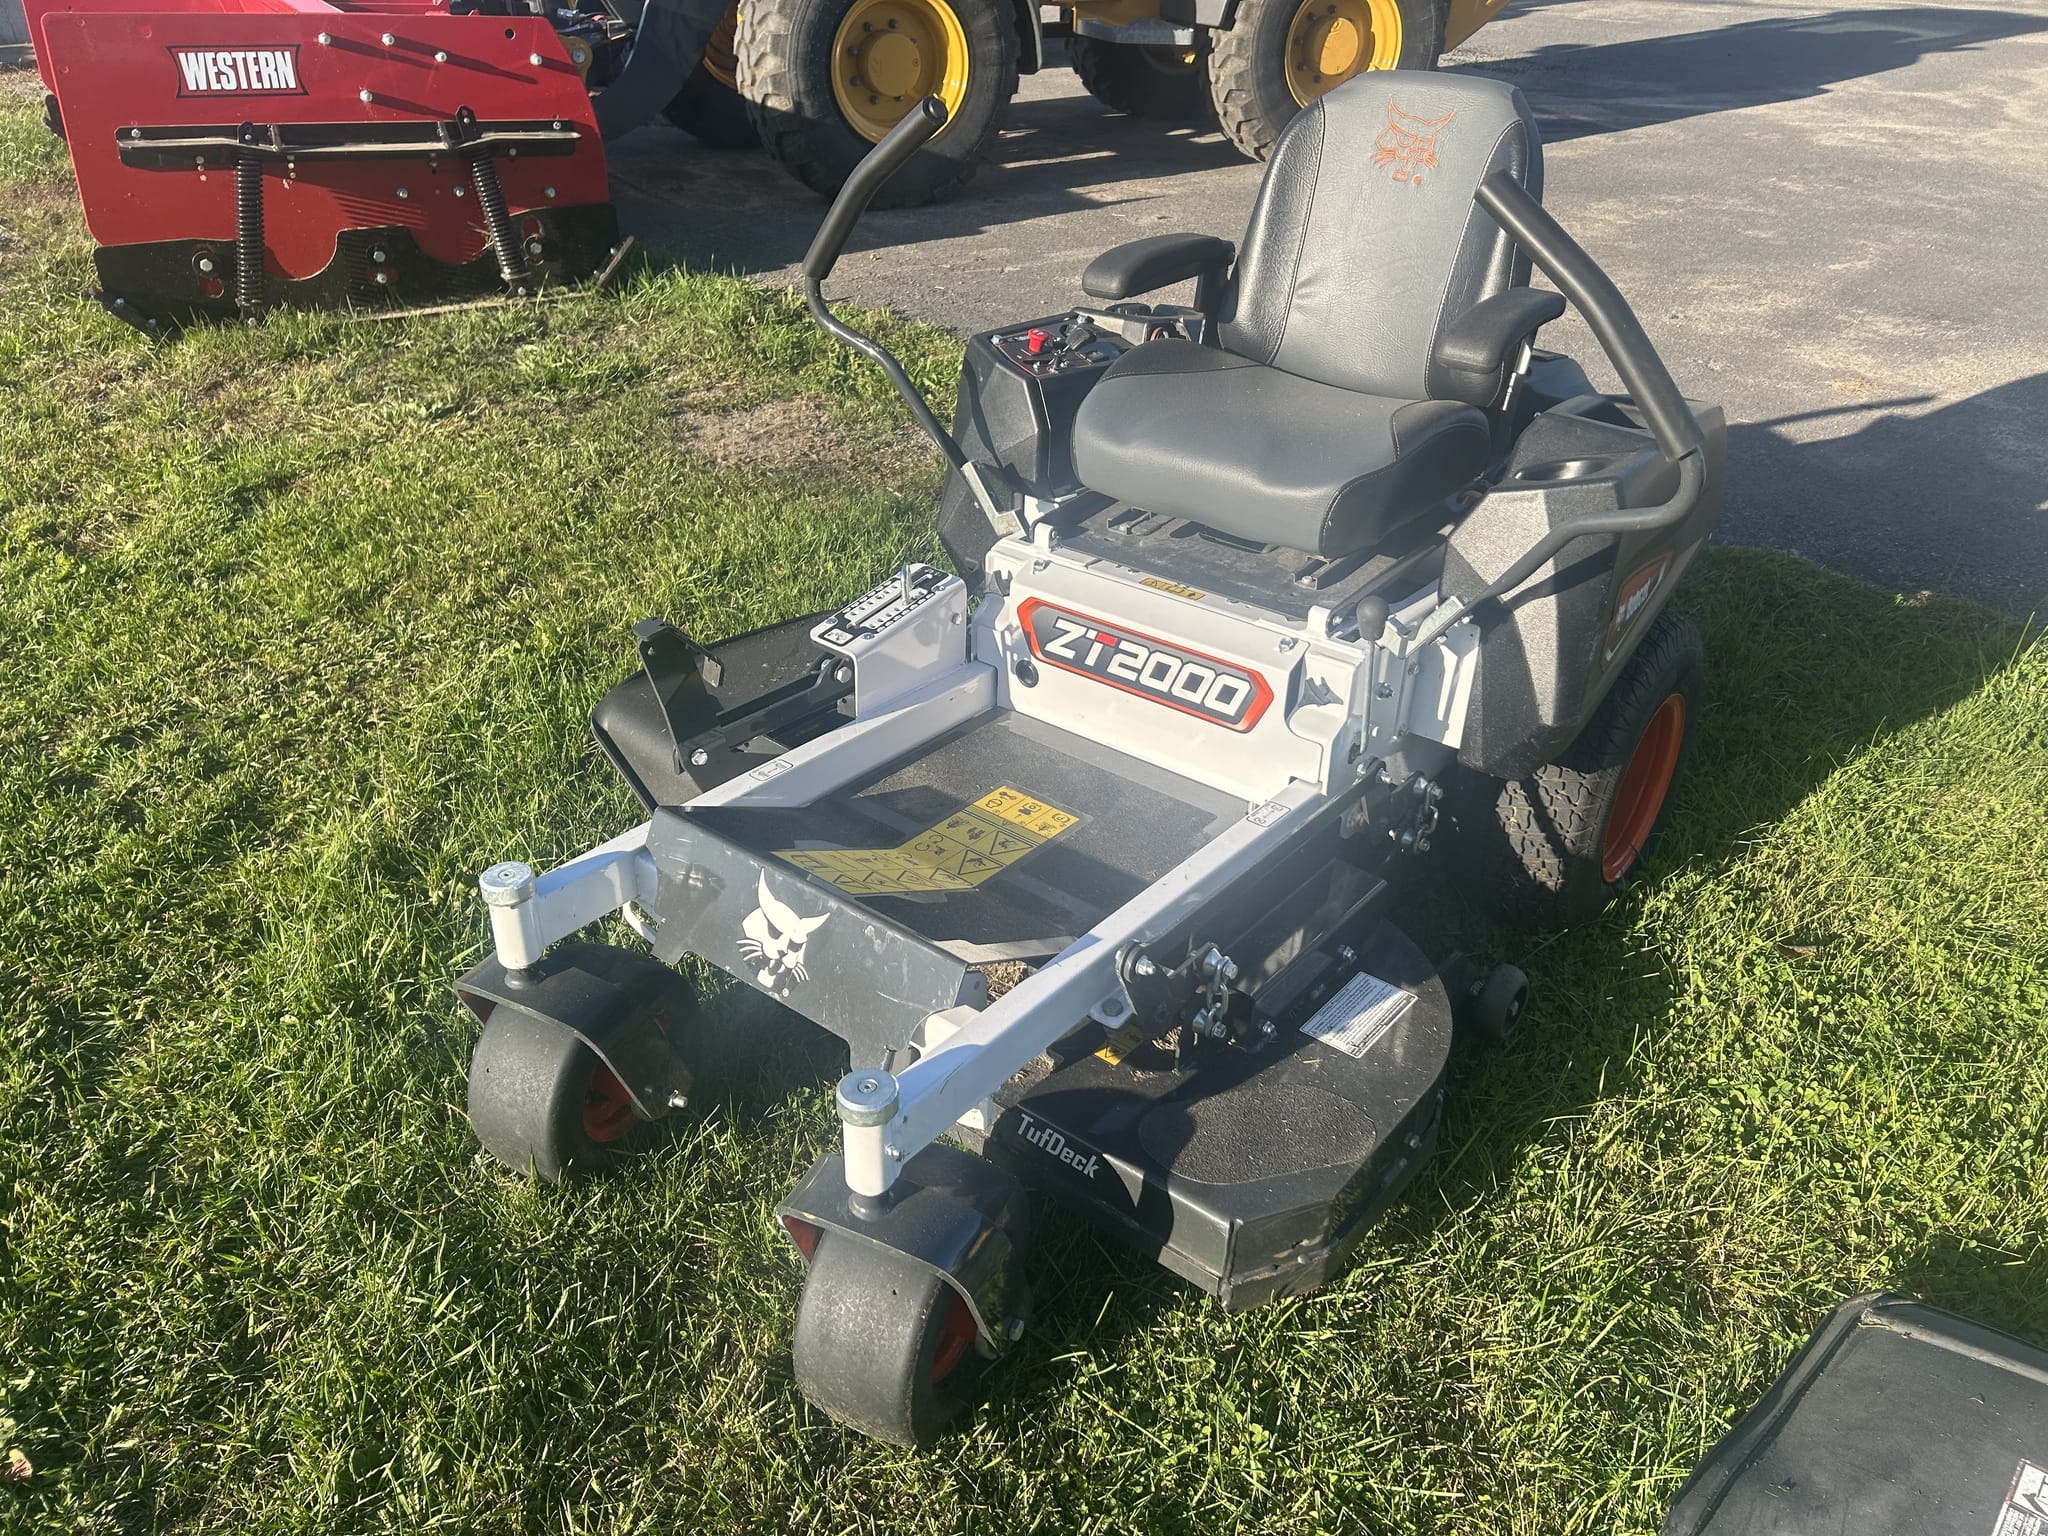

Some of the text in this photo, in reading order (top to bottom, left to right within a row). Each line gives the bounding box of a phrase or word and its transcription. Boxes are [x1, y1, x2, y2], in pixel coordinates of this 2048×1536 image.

[178, 51, 297, 91] WESTERN
[1044, 616, 1251, 717] ZT2000
[1017, 1113, 1100, 1179] TufDeck
